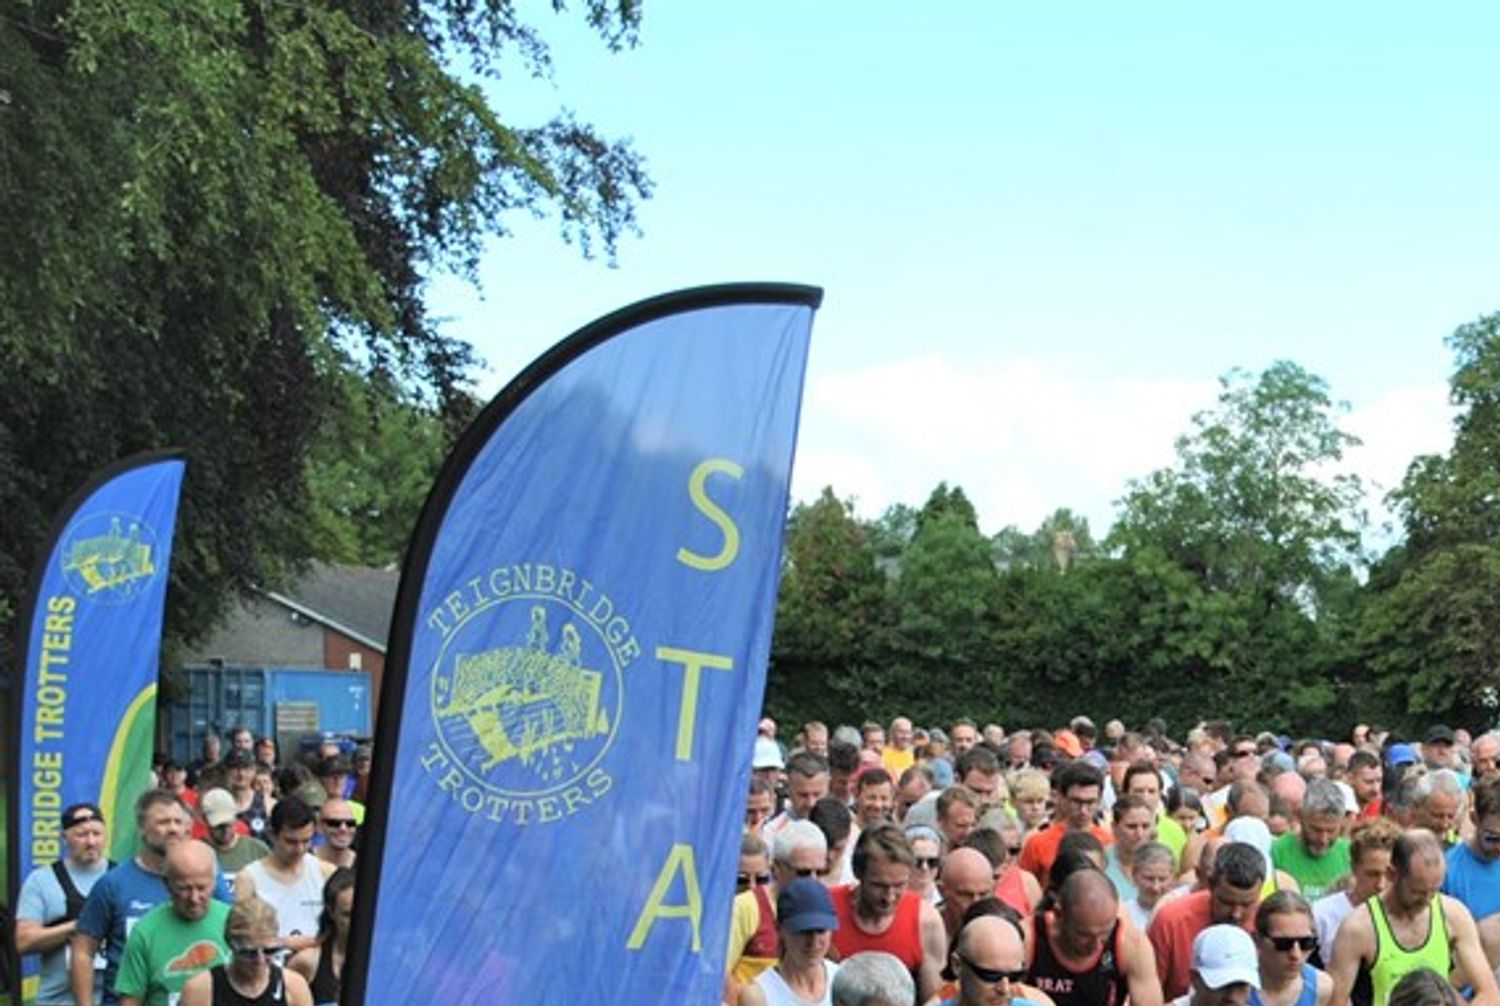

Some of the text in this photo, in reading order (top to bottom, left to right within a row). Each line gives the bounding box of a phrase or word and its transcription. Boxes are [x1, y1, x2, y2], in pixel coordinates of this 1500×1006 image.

[428, 563, 642, 668] TEIGNBRIDGE
[34, 596, 76, 743] TROTTERS
[420, 743, 614, 827] TROTTERS
